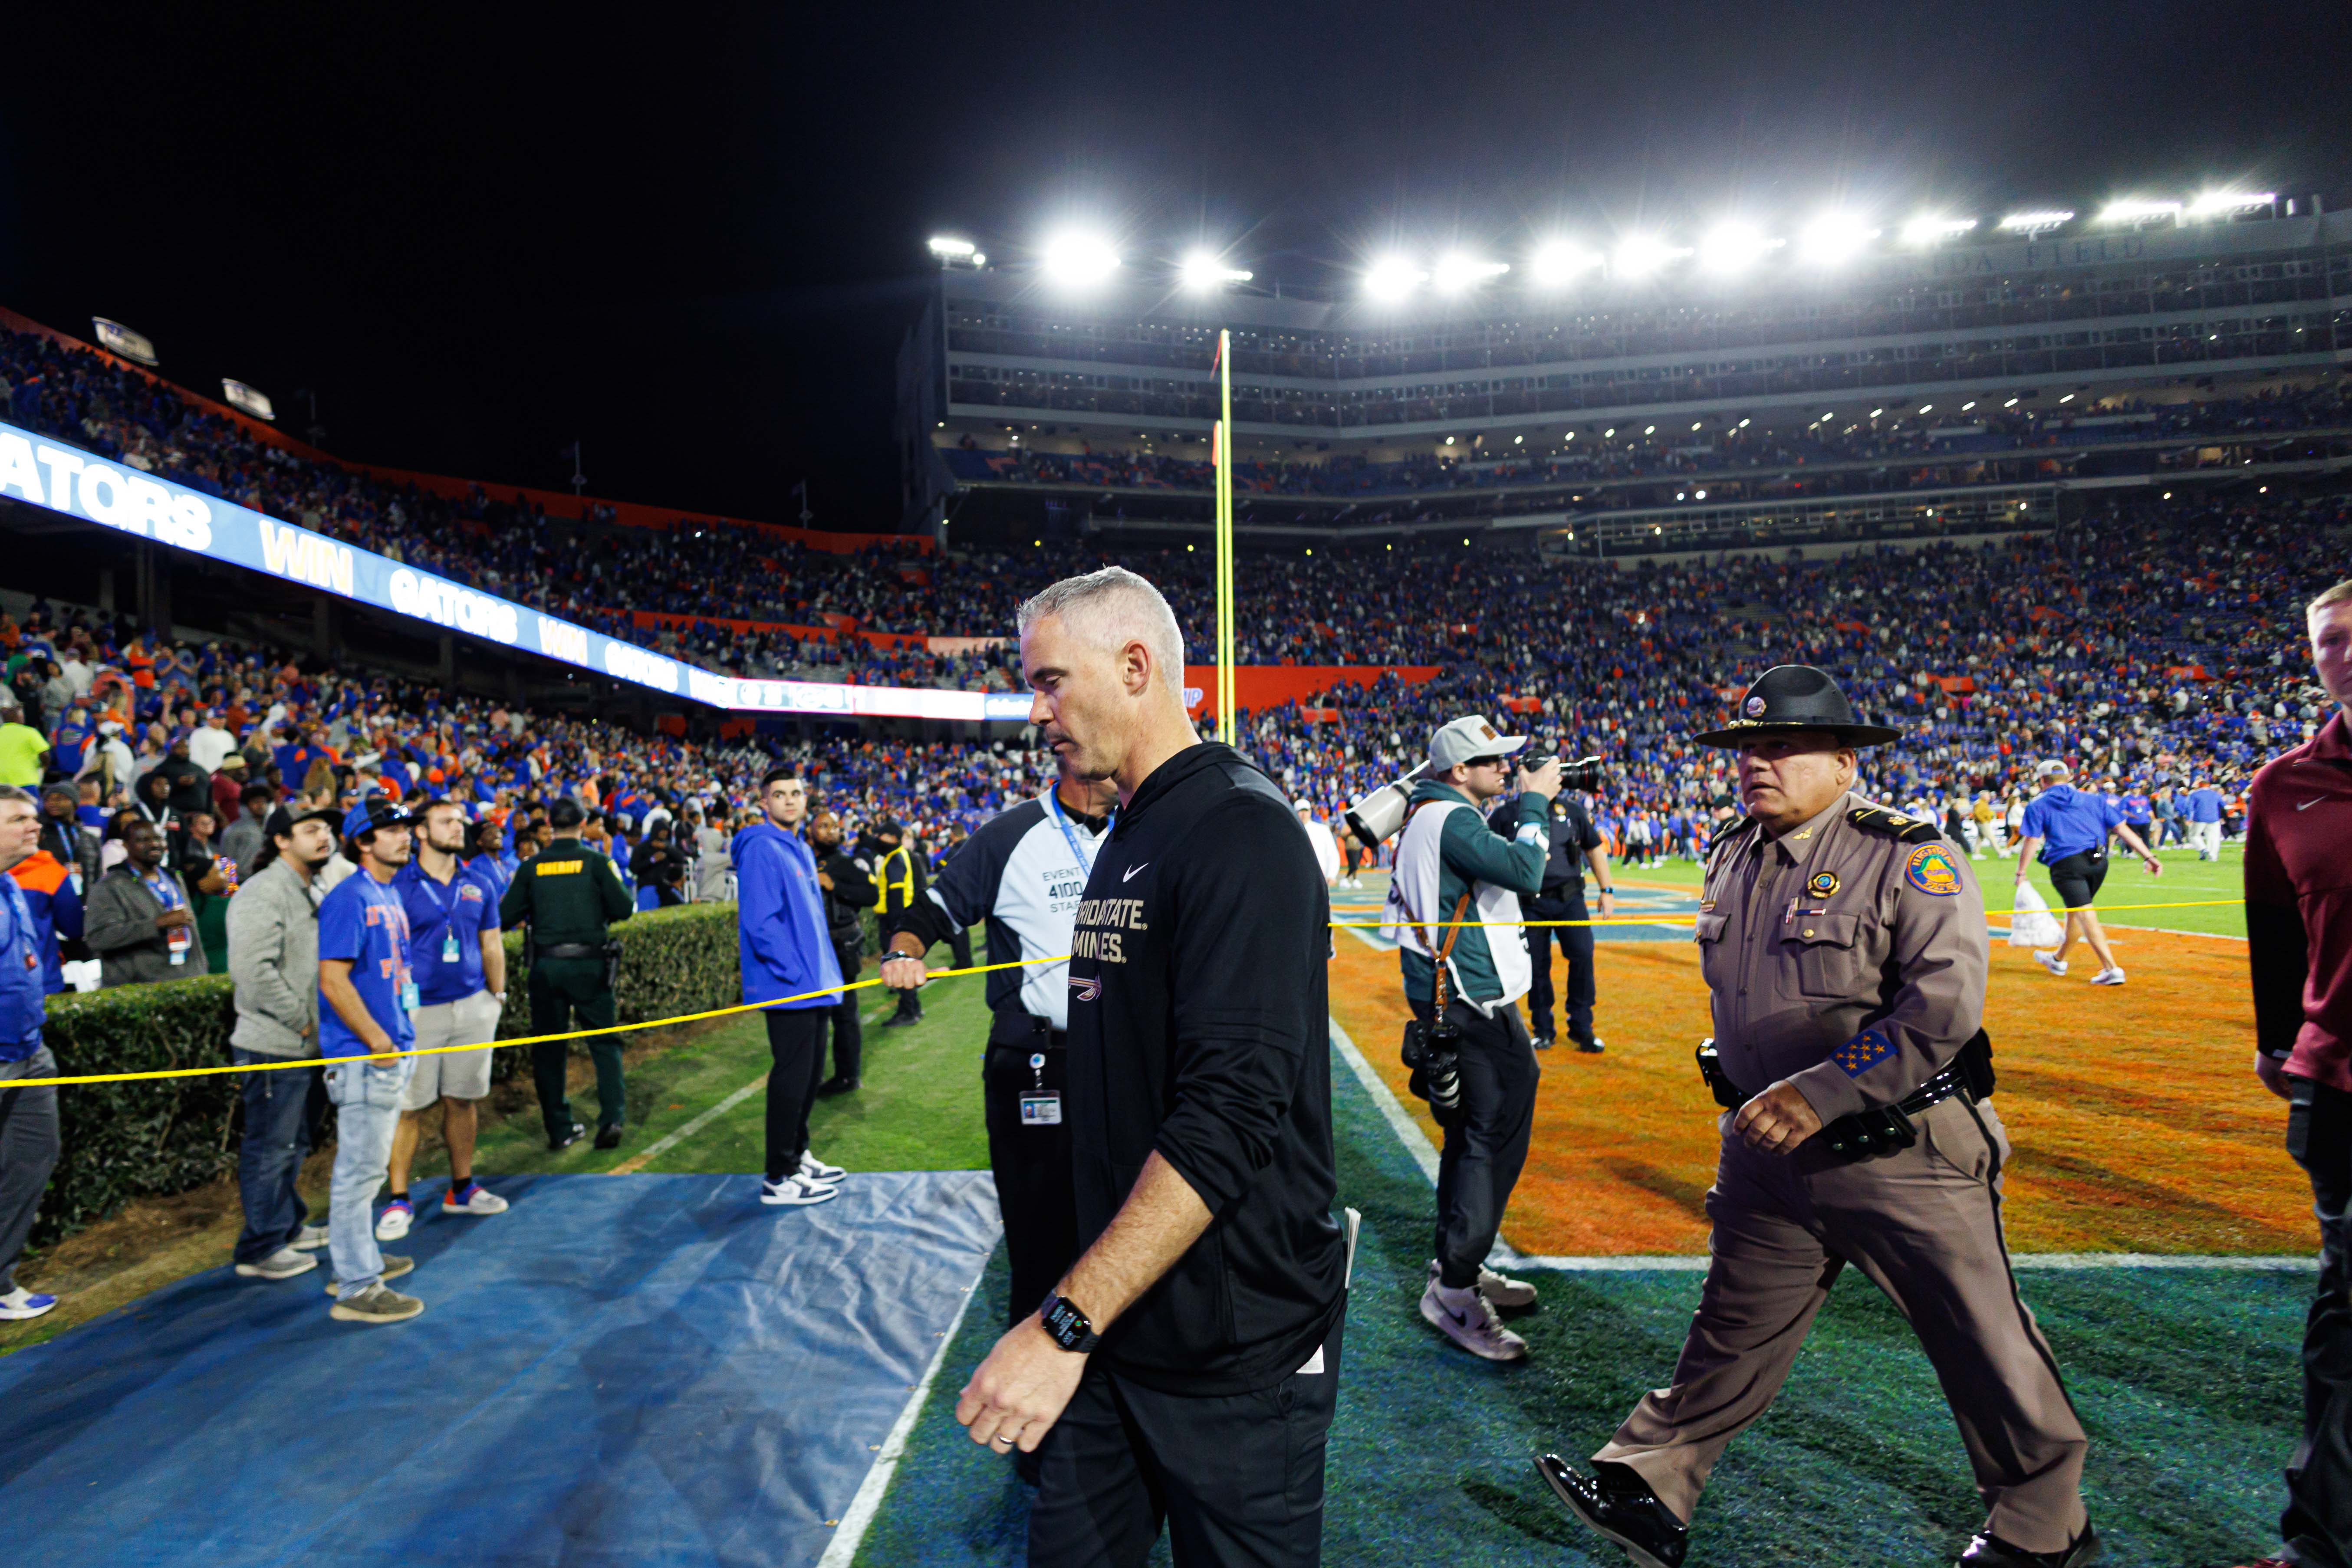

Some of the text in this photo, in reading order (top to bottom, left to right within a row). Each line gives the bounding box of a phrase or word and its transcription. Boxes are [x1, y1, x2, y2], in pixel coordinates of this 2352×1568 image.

[2026, 237, 2143, 268] FIELD
[259, 519, 353, 597] WIN
[389, 569, 518, 644] GATORS
[538, 616, 588, 666] WIN
[1043, 867, 1080, 881] EVENT
[1049, 881, 1083, 899] 4100
[1075, 898, 1144, 930] ORIDA TATE
